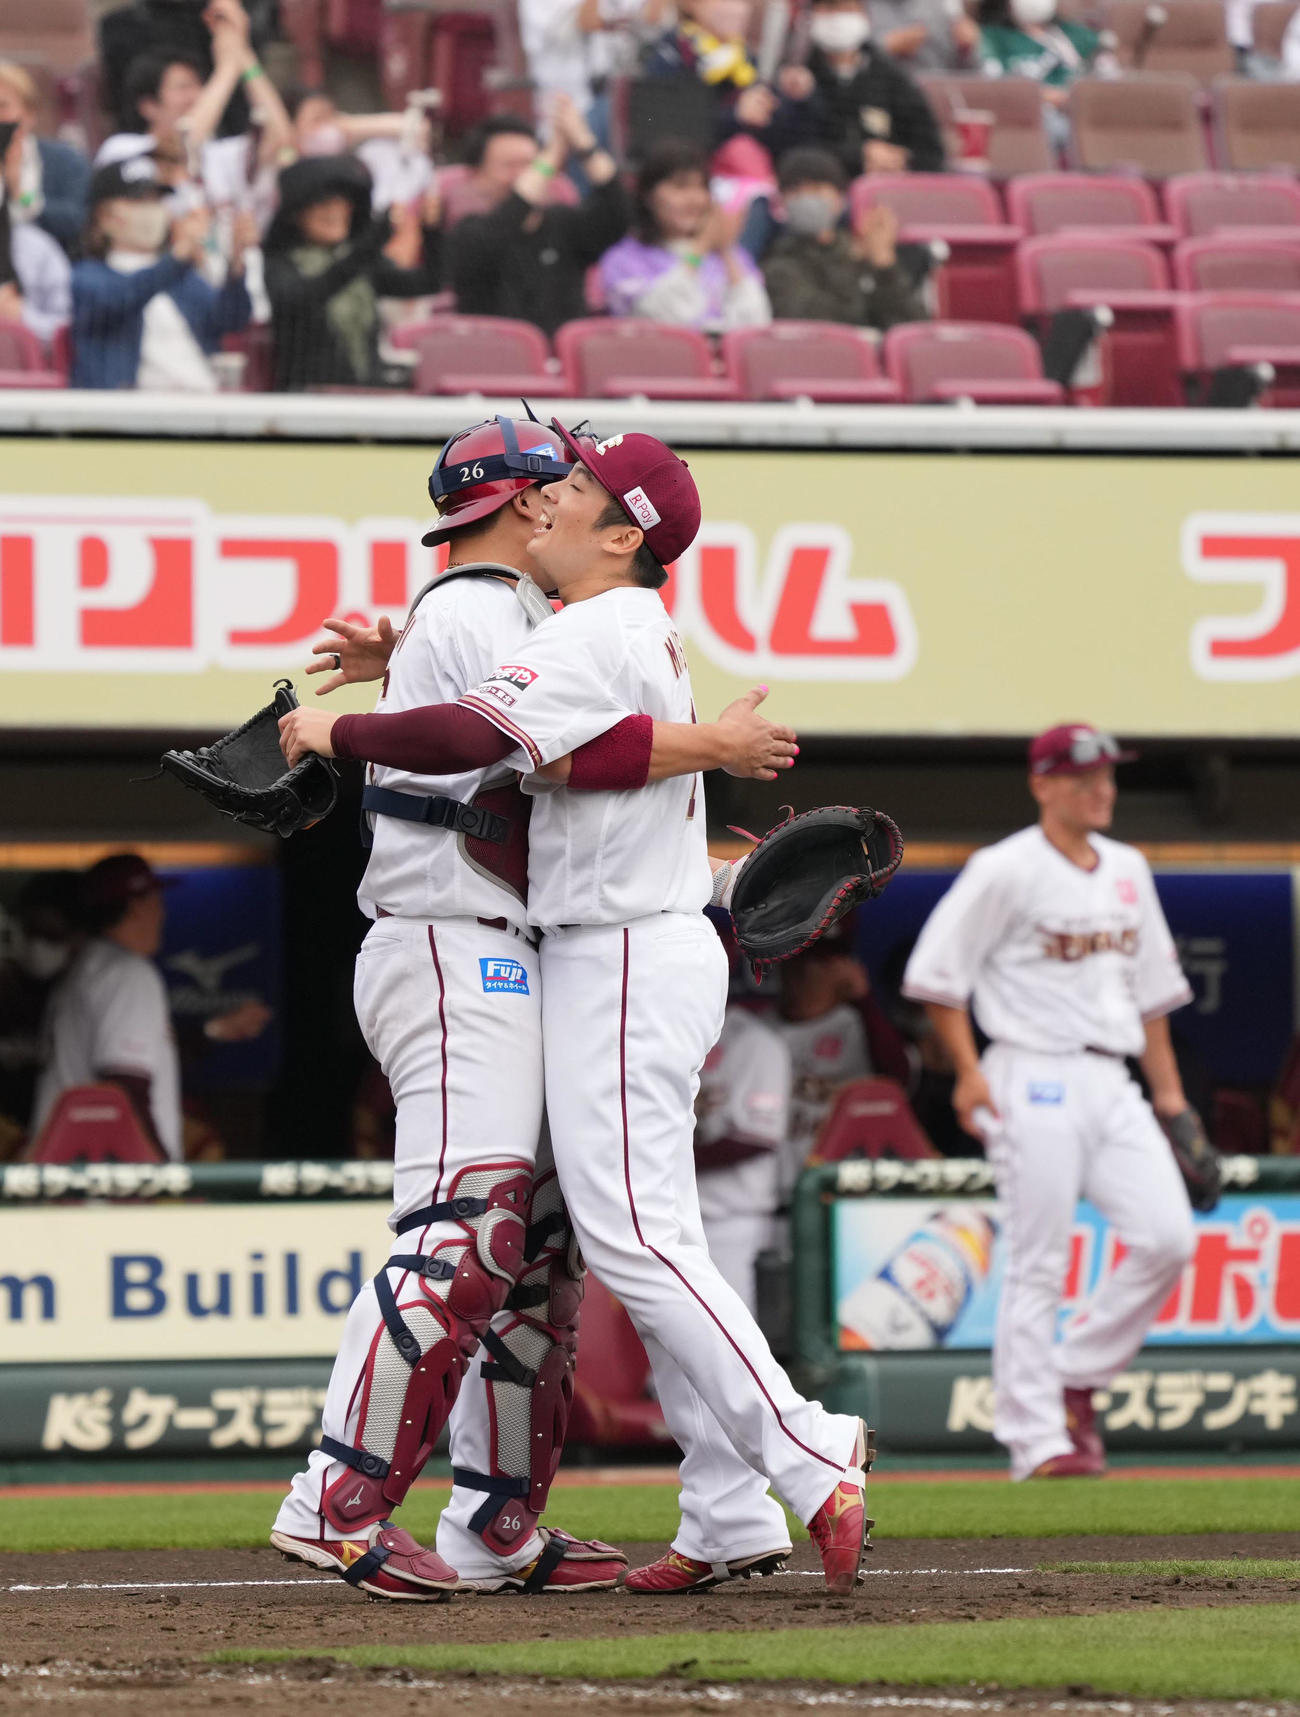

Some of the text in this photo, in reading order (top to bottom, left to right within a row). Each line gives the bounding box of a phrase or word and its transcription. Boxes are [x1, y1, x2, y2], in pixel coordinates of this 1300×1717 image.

[459, 461, 485, 482] 26
[637, 503, 654, 524] Pay
[486, 961, 523, 981] Fuji
[110, 1251, 362, 1318] Build
[122, 1387, 327, 1449] ケーズデ
[502, 1515, 520, 1530] 26
